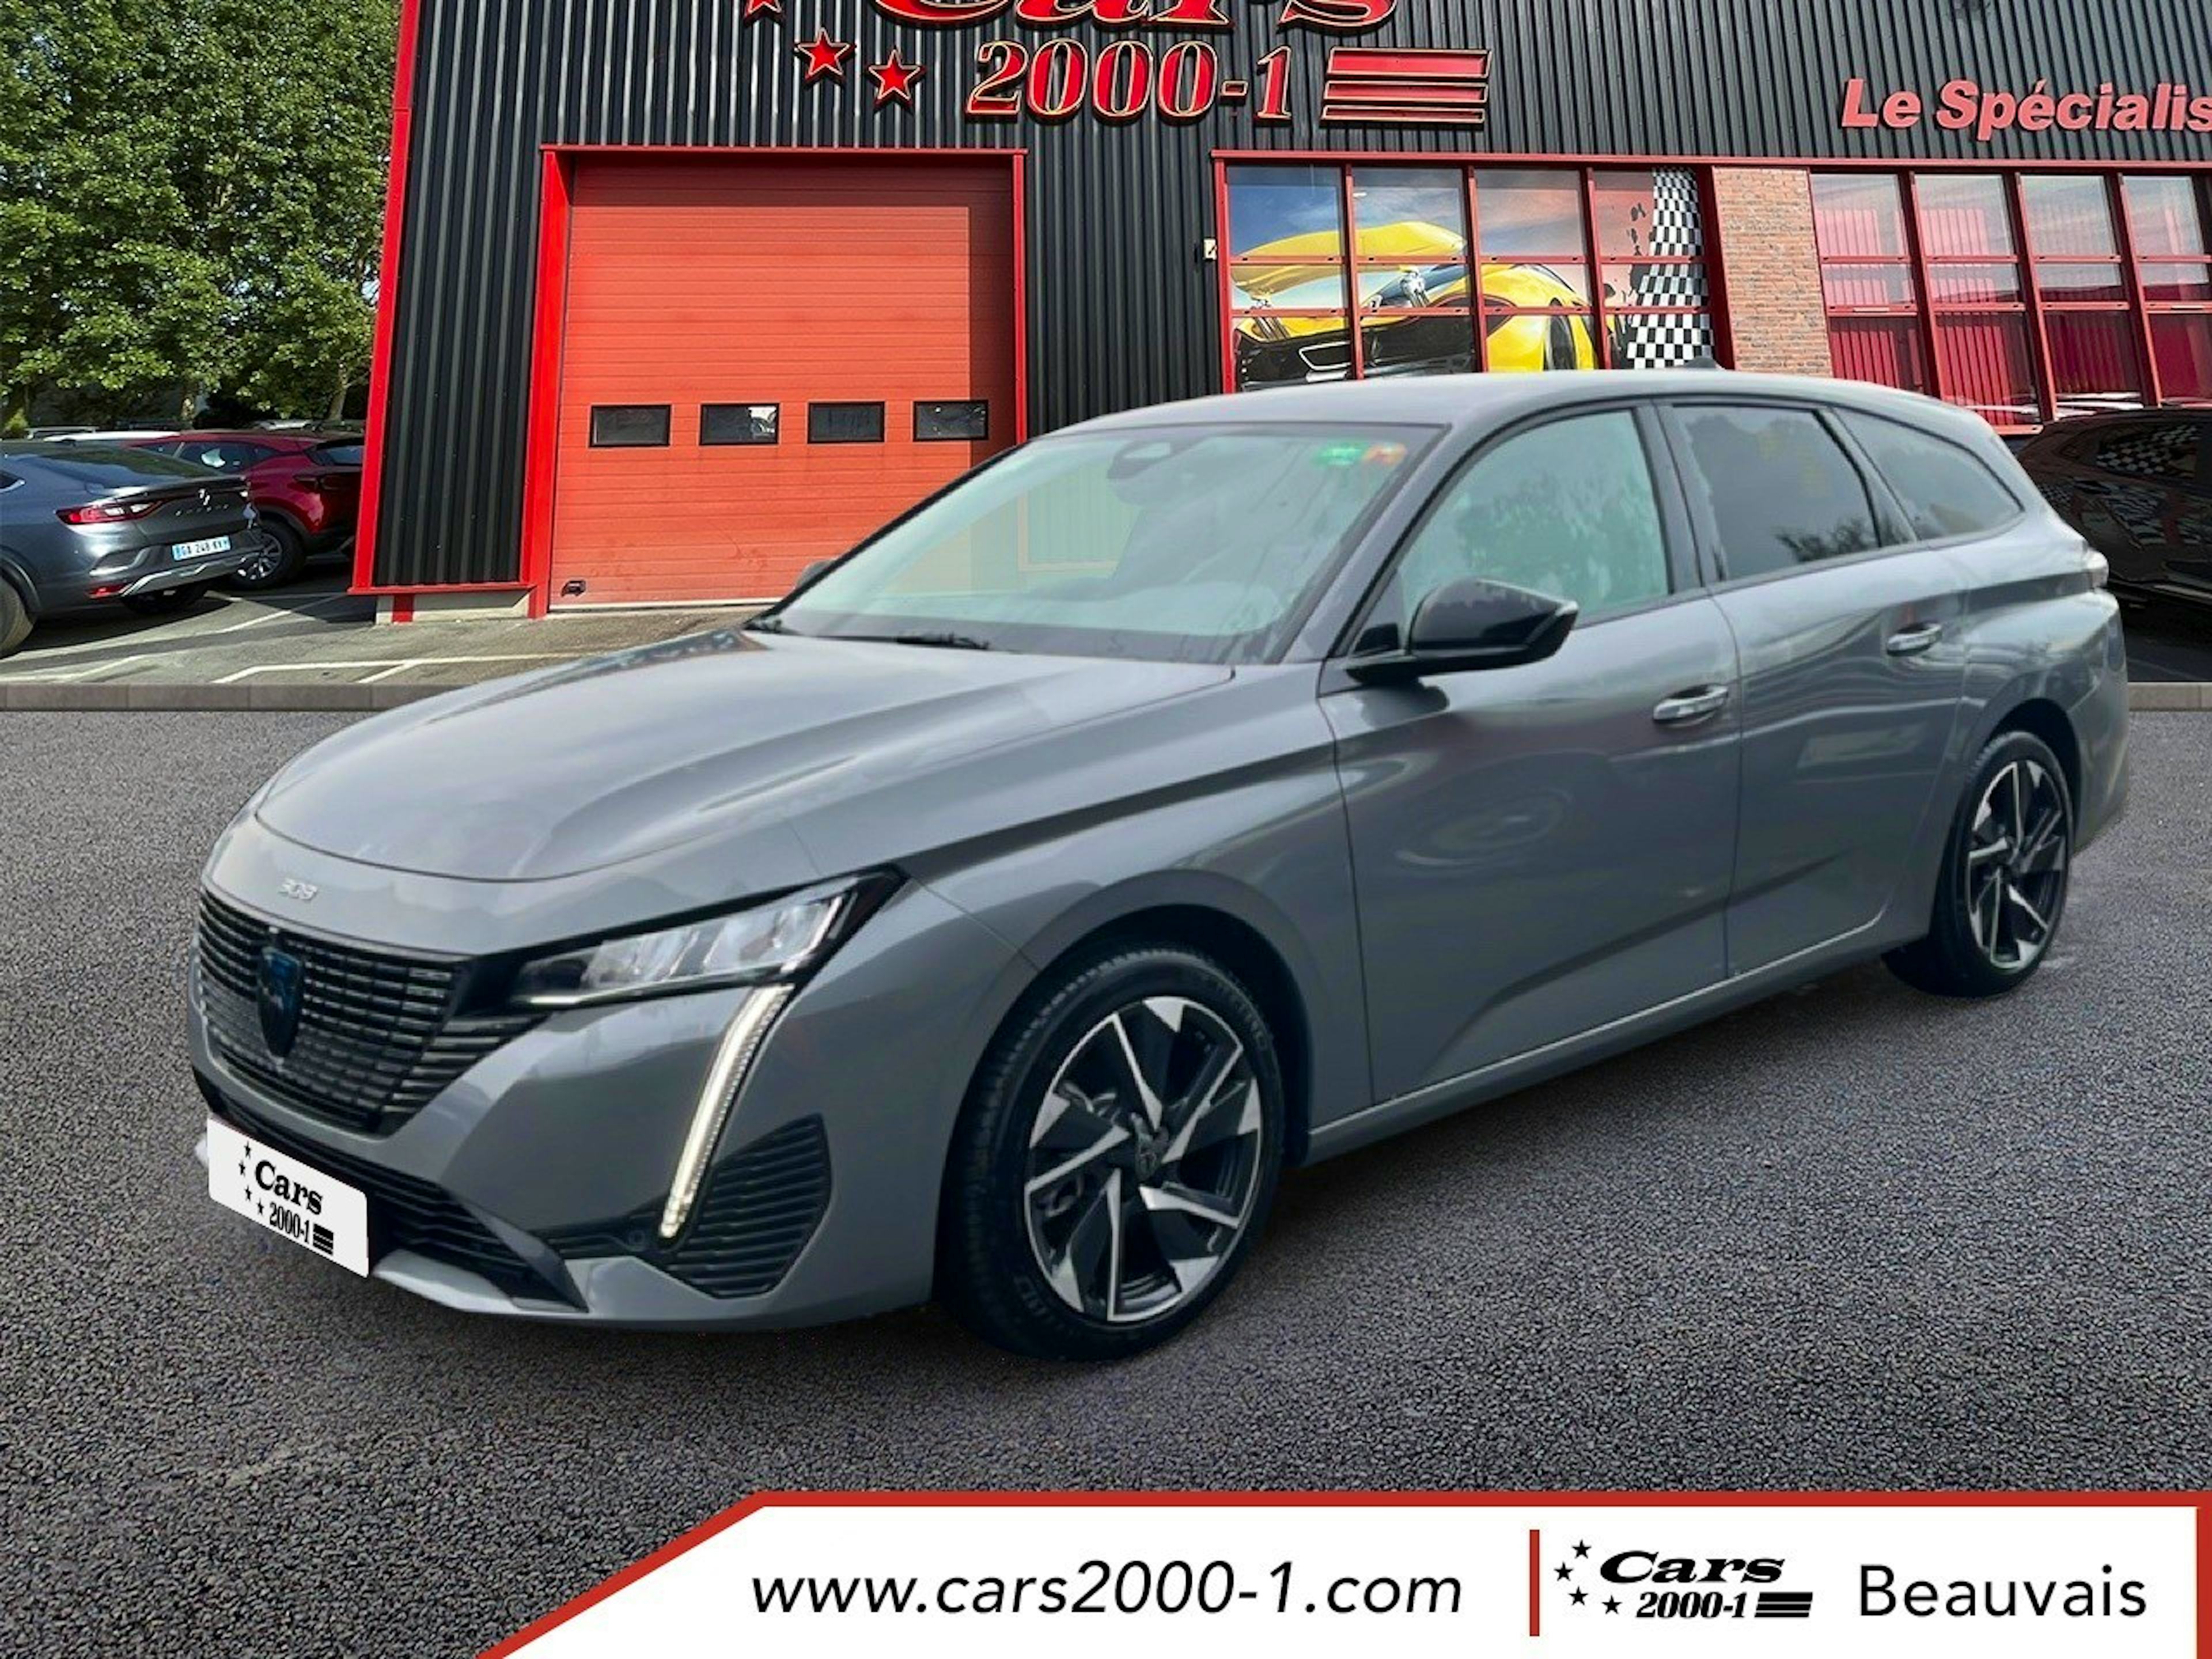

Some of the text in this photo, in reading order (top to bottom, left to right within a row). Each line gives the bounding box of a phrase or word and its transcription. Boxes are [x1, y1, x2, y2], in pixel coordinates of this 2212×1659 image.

[964, 40, 1291, 122] 2000-1
[1842, 77, 2212, 142] Le Spécialis
[255, 1160, 323, 1215] Cars
[270, 1202, 310, 1243] 2000-1
